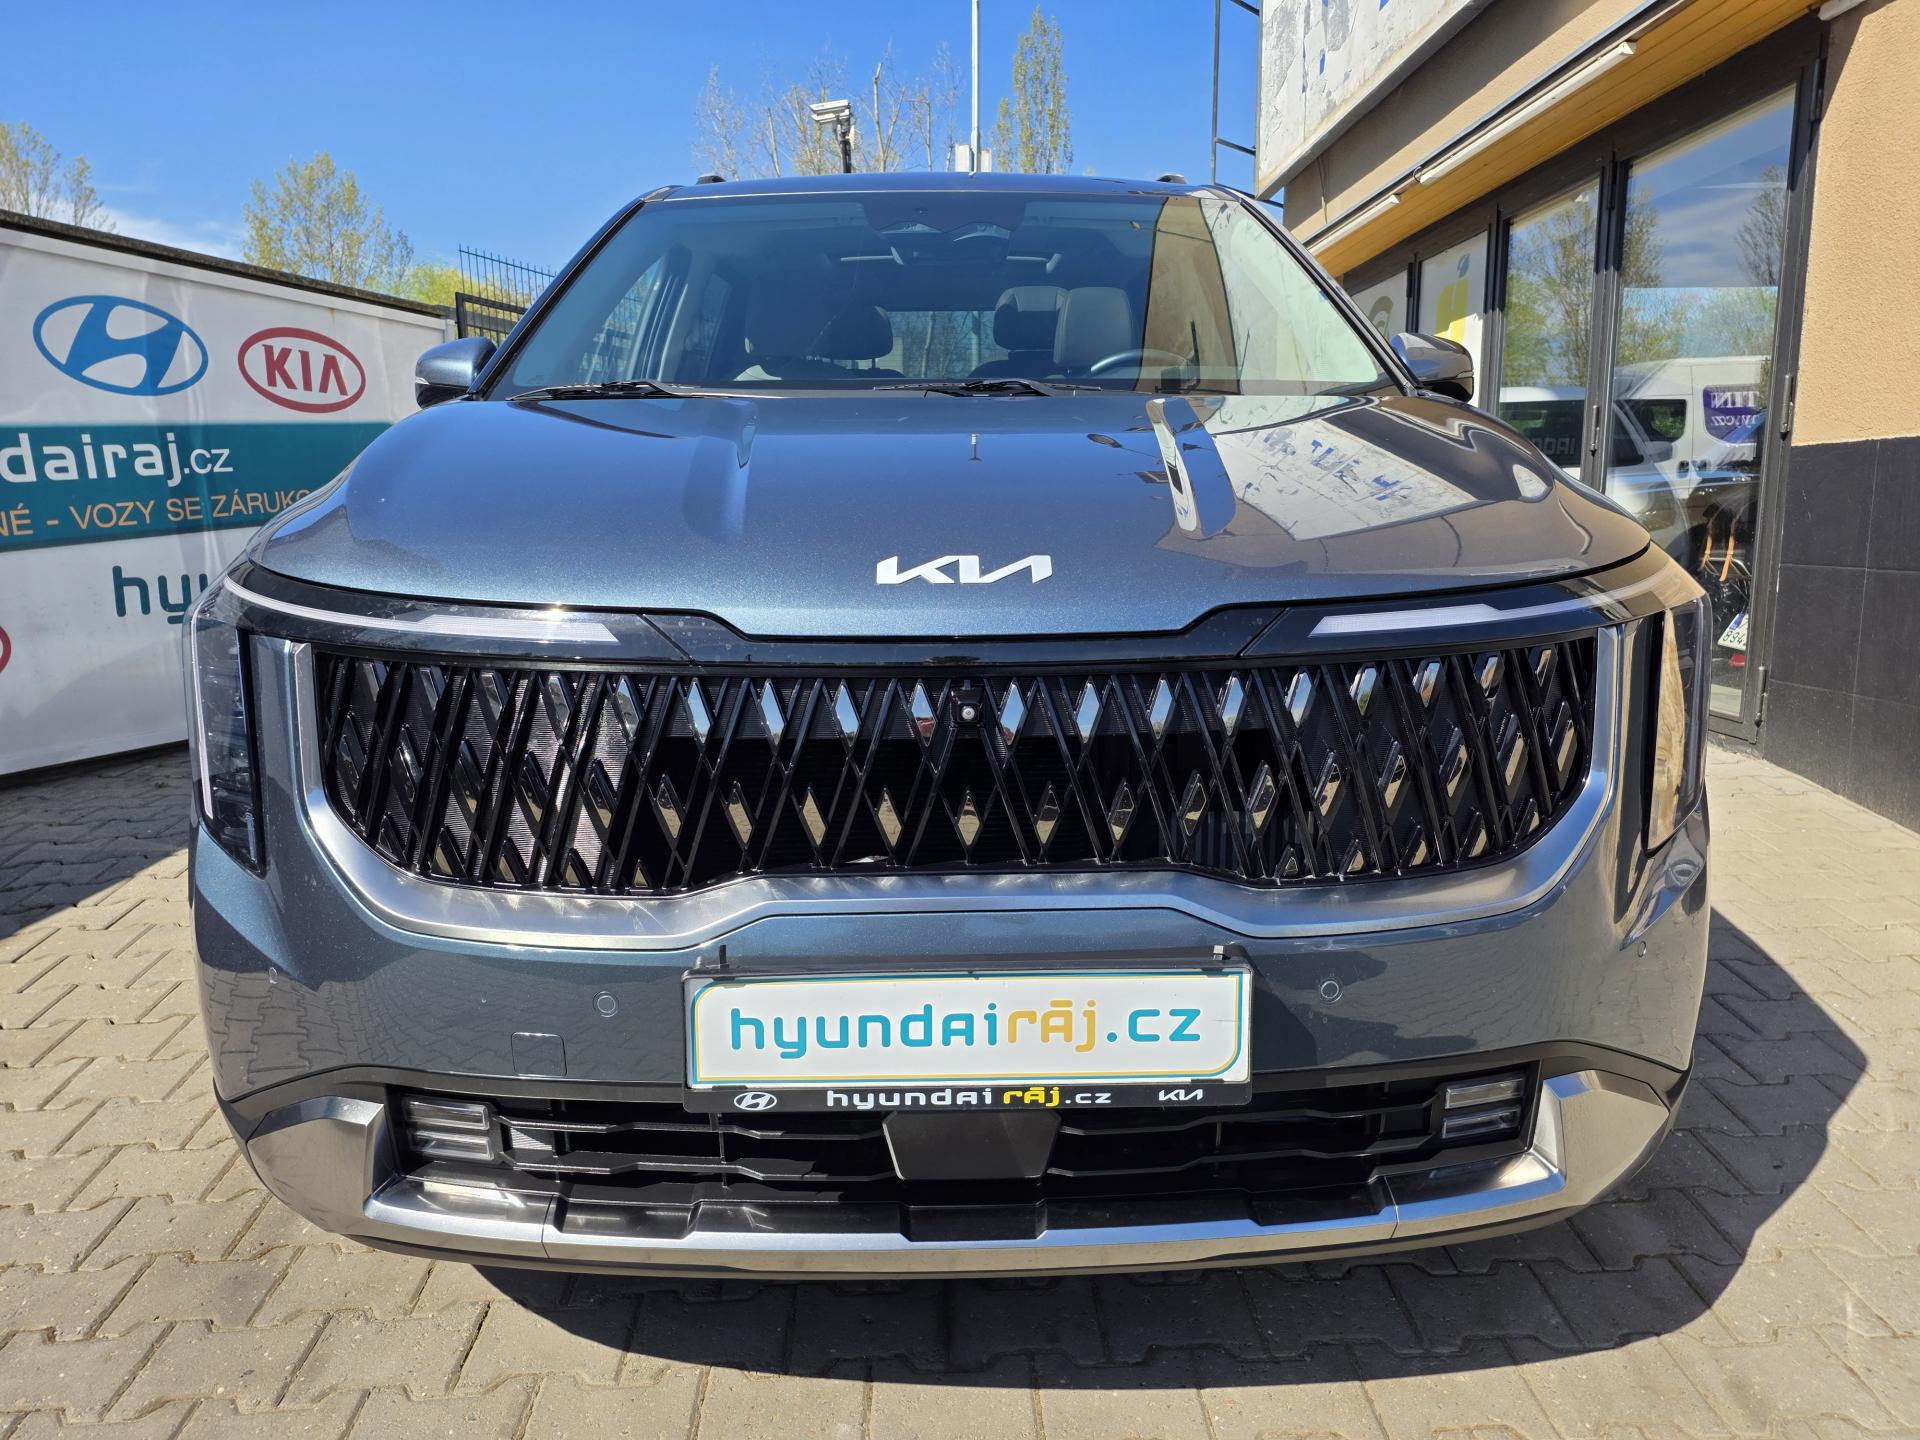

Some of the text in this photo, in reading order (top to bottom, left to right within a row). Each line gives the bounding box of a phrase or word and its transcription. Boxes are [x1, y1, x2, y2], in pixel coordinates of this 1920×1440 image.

[262, 343, 349, 397] KIA
[69, 500, 155, 530] VOZY
[166, 497, 204, 523] SE
[112, 565, 209, 625] hy
